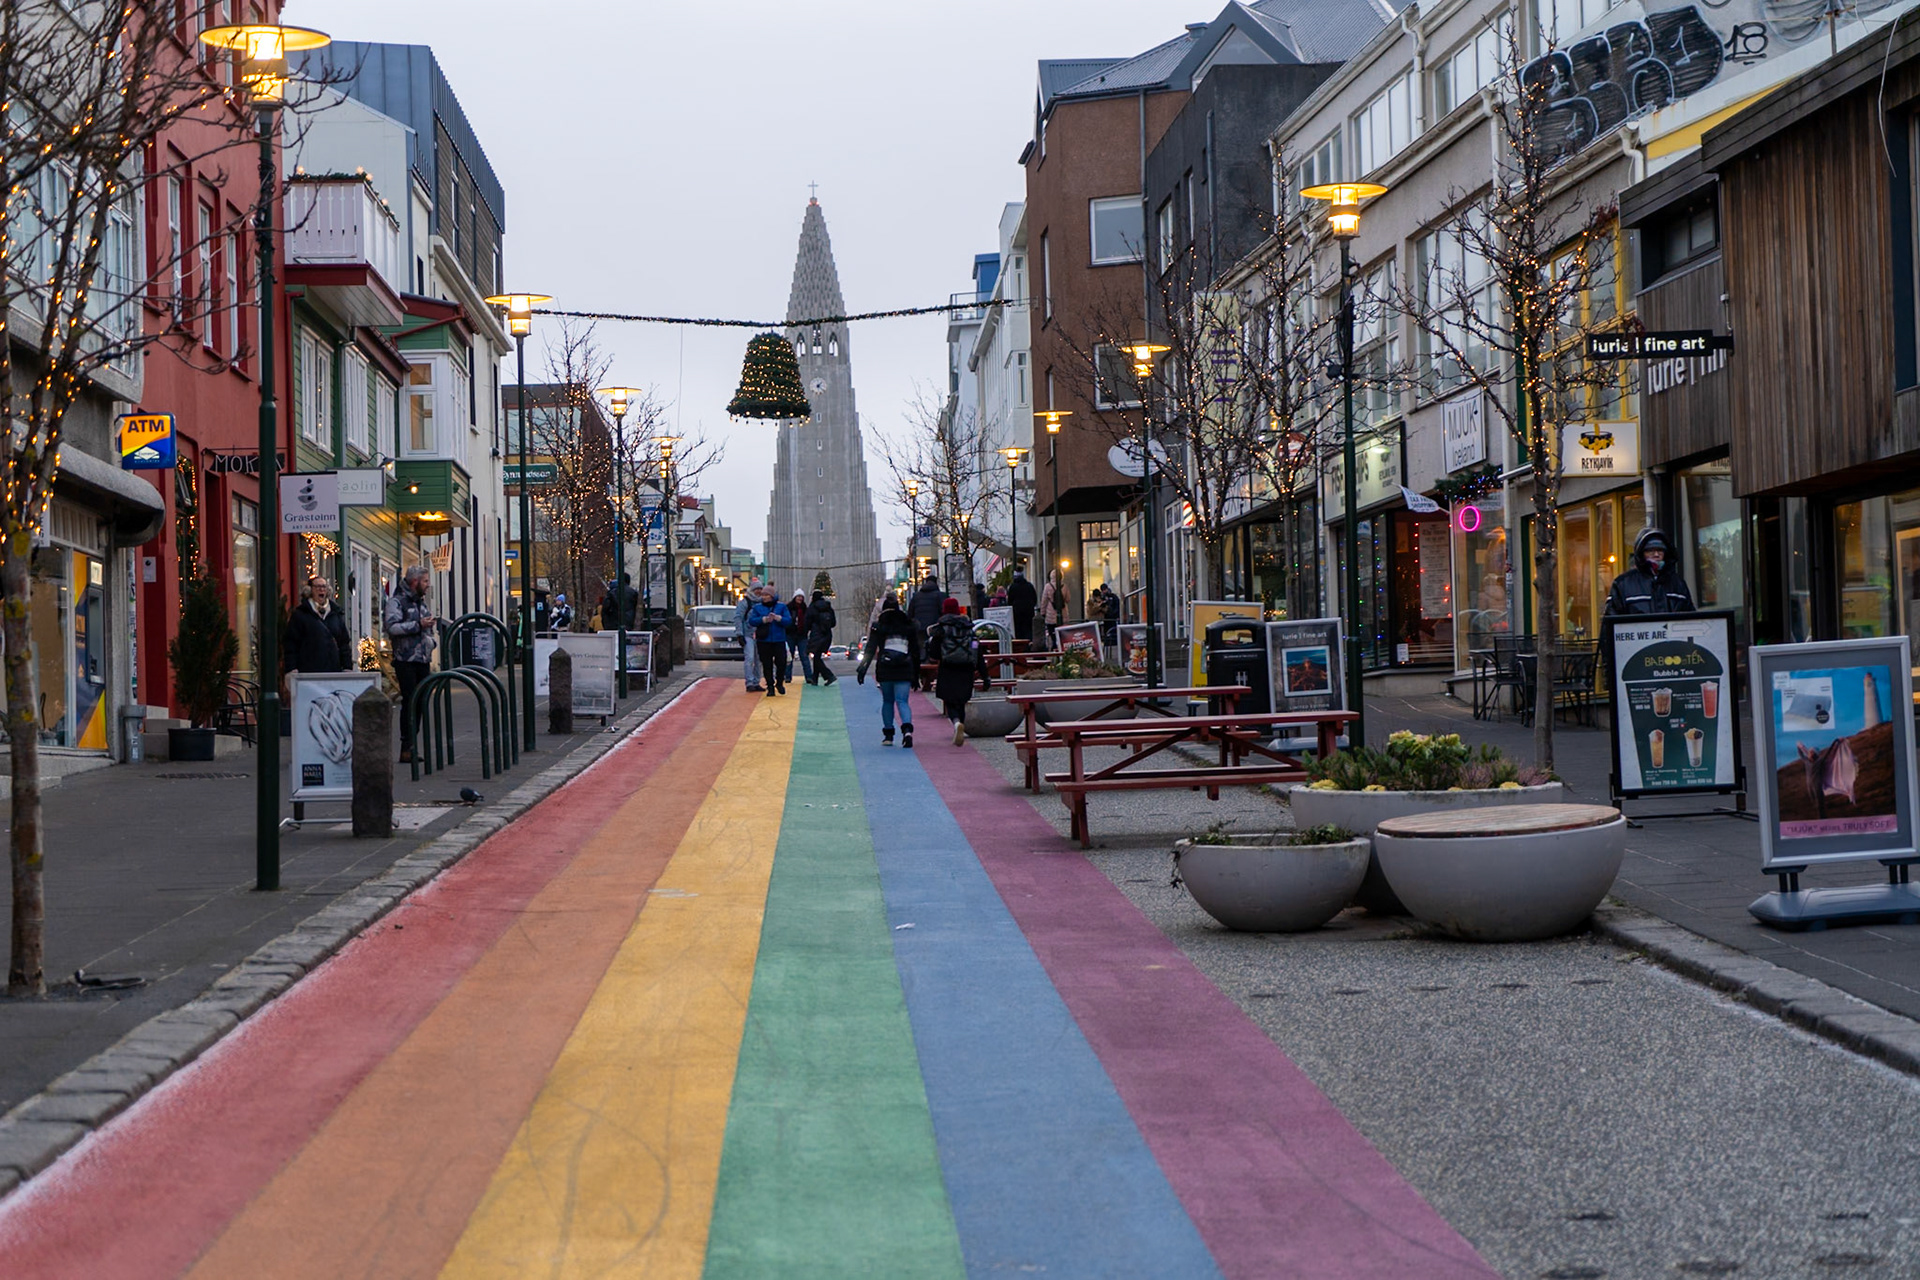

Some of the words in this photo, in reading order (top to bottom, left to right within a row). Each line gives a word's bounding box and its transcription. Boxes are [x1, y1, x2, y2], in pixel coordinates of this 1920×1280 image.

[1644, 337, 1677, 352] fine
[1681, 337, 1705, 350] art
[1647, 357, 1685, 395] iurie
[127, 419, 165, 433] ATM
[1452, 438, 1476, 467] Iceland
[1615, 632, 1635, 641] HERE
[1637, 631, 1650, 640] WE
[1652, 630, 1667, 639] ARE
[1843, 822, 1867, 831] TRULY
[1869, 820, 1889, 828] SOFT
